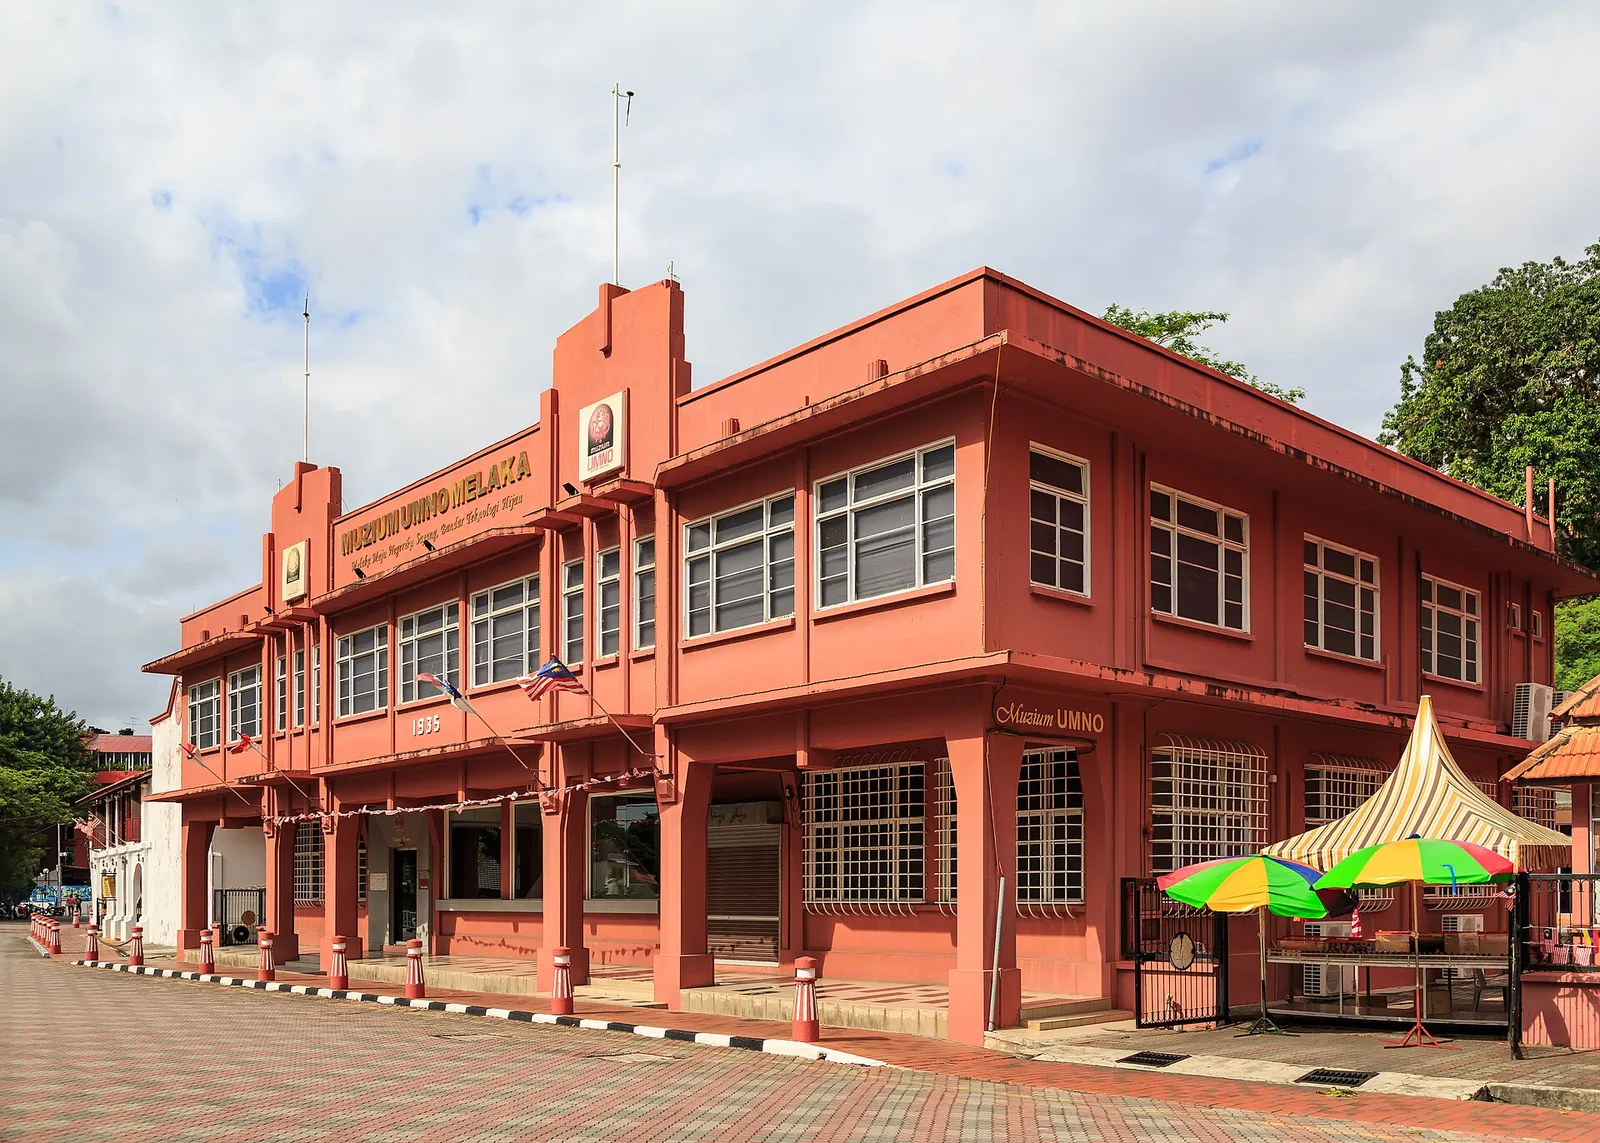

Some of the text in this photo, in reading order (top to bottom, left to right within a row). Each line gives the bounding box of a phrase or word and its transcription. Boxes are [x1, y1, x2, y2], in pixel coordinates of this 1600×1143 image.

[588, 448, 614, 471] UMNO
[341, 450, 531, 556] MUZIUM UMNO MELAKA
[440, 515, 465, 535] Bandar
[466, 501, 500, 525] Teknologi
[501, 494, 524, 511] Hijau
[412, 714, 440, 736] 1935
[996, 702, 1104, 733] Muzium UMNO
